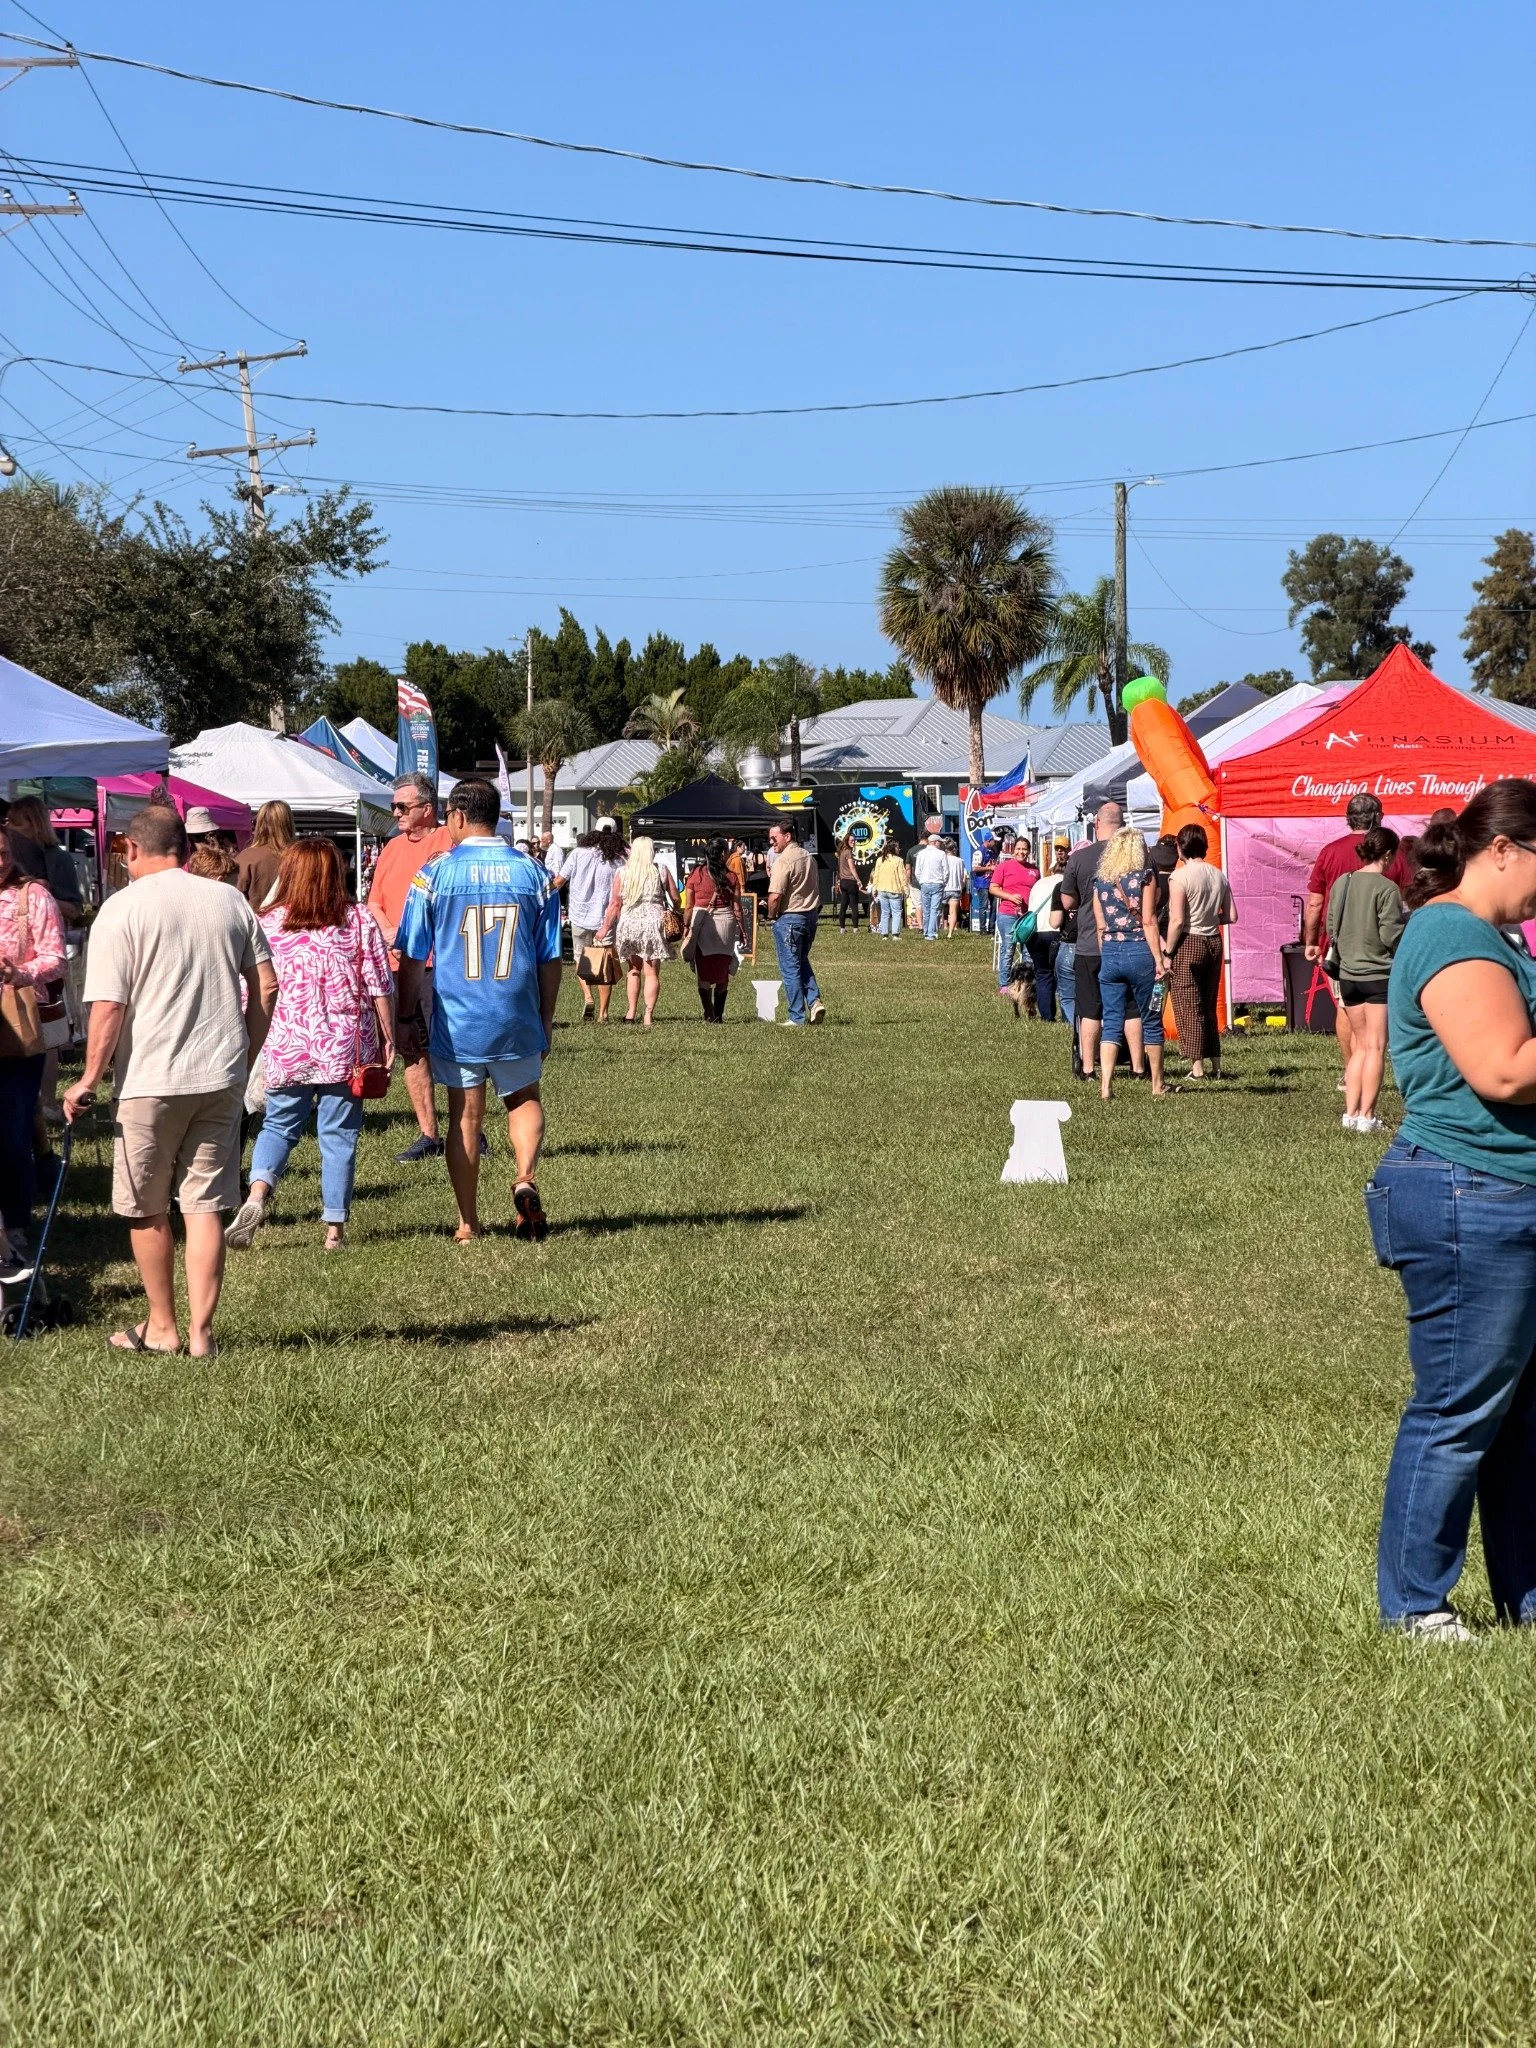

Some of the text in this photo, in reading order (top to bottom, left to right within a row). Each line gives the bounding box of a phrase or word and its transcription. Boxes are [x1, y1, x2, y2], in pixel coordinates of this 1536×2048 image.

[417, 749, 429, 777] FRES
[1291, 774, 1486, 804] Changing Lives Through
[470, 864, 511, 884] RVERS
[459, 903, 519, 980] 17
